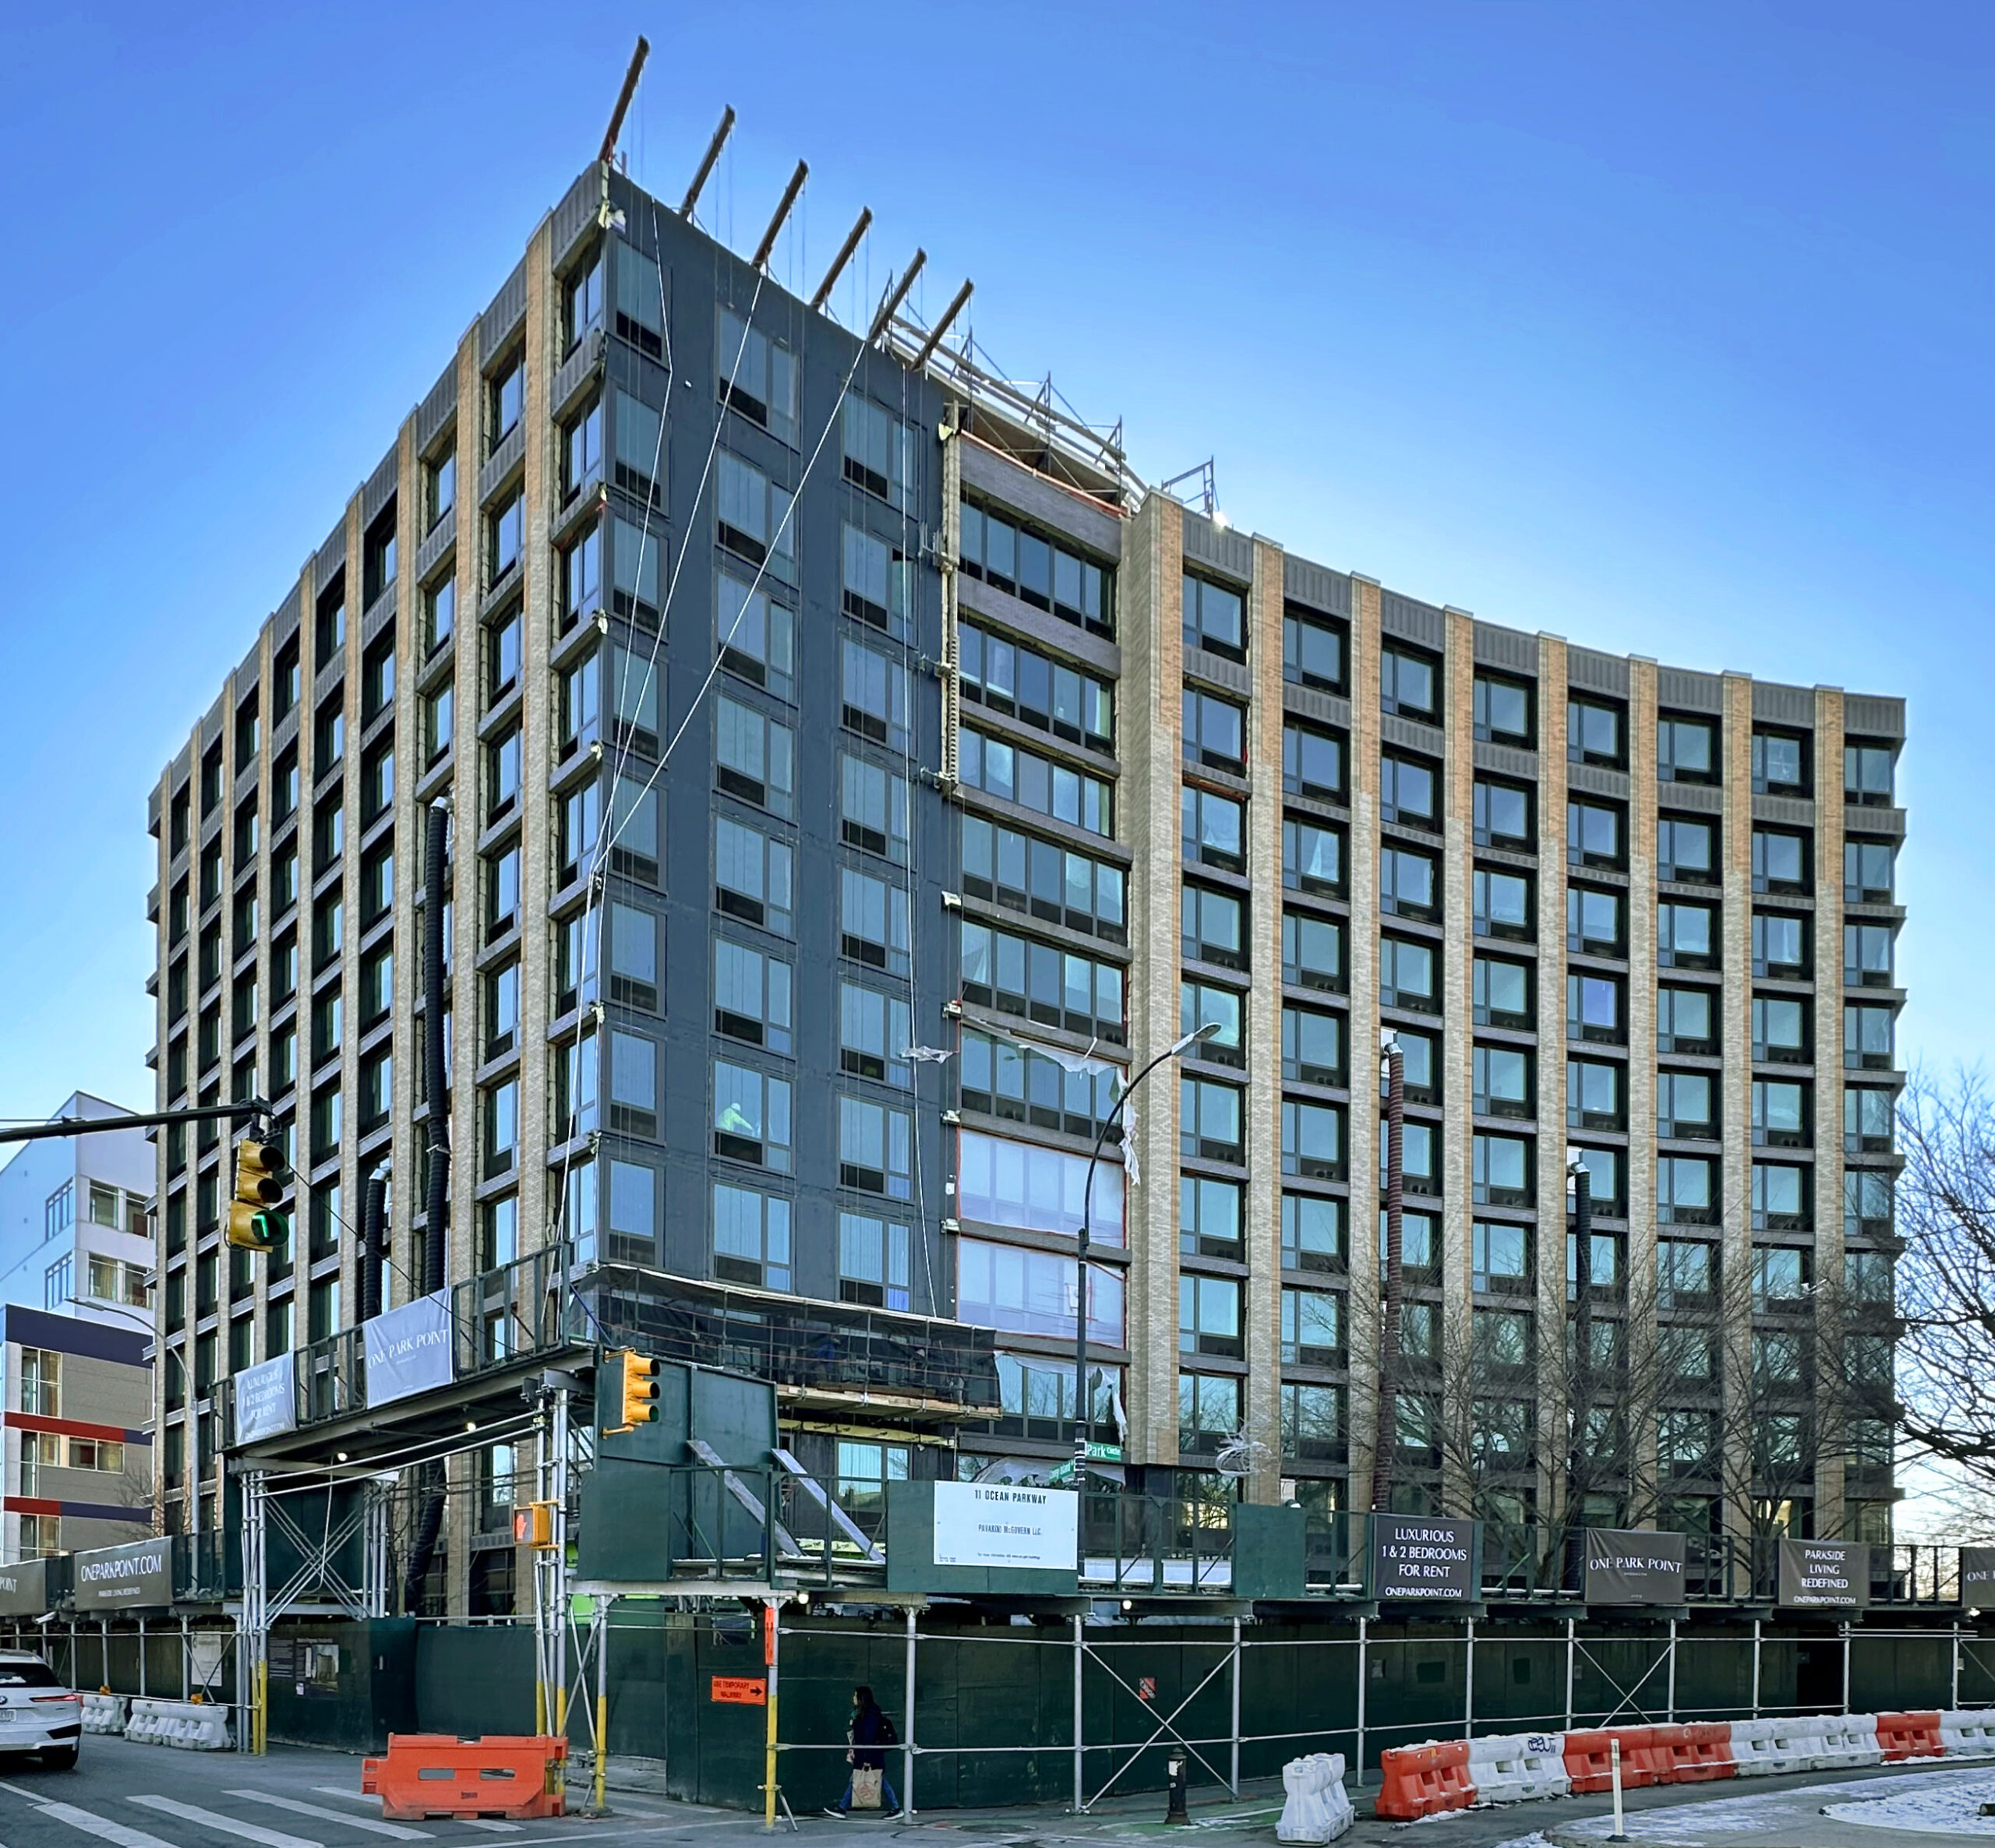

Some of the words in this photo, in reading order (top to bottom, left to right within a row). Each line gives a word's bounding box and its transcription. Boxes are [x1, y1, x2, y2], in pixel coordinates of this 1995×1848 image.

[389, 1336, 414, 1359] PARK
[416, 1329, 448, 1349] POINT
[1087, 1444, 1107, 1458] Park
[974, 1490, 982, 1500] 11
[984, 1490, 1009, 1502] OCEAN
[1012, 1493, 1047, 1504] PARKWAY
[1395, 1528, 1455, 1543] LUXURIOUS
[1382, 1545, 1386, 1557] 1
[1389, 1545, 1398, 1558] &
[1400, 1546, 1407, 1558] 2
[1409, 1546, 1467, 1561] BEDROOMS
[1805, 1549, 1846, 1561] PARKSIDE
[81, 1554, 162, 1582] ONEPARKPOINT.COM
[1399, 1564, 1421, 1577] FOR
[1423, 1565, 1451, 1578] RENT
[1616, 1557, 1645, 1568] PARK
[1648, 1558, 1683, 1573] POINT
[1810, 1564, 1840, 1575] LIVING
[1801, 1577, 1848, 1589] REDEFINED
[1385, 1586, 1462, 1598] ONEPARKPOINT.COM
